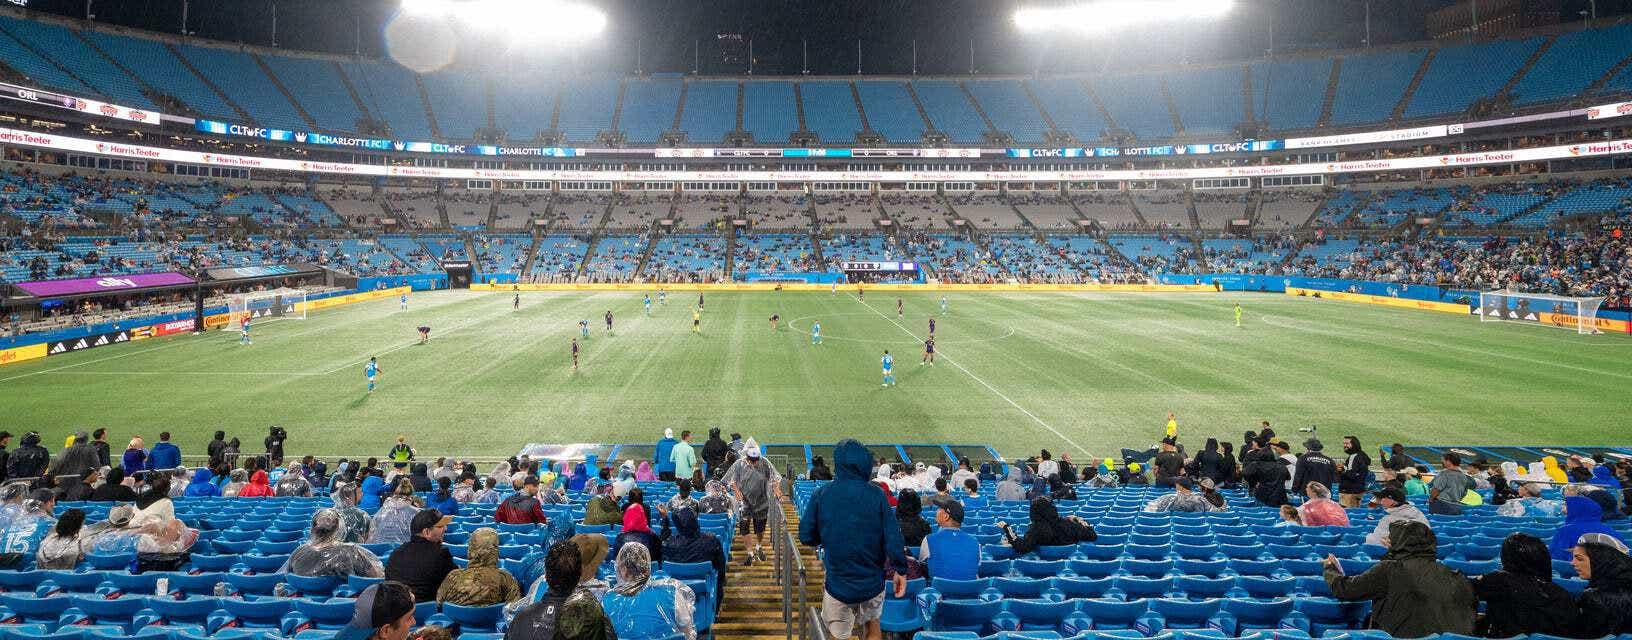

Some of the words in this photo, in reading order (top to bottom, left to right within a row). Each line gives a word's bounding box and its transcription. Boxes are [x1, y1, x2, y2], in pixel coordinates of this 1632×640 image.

[18, 89, 38, 101] ORL
[0, 131, 23, 142] arris
[24, 134, 51, 145] Teeter
[320, 135, 369, 148] CHARLOTTE
[371, 139, 382, 148] FC
[110, 145, 135, 155] Harris
[136, 147, 160, 158] Teeter
[498, 147, 541, 156] CHARLOTTE
[1588, 144, 1622, 153] Harris
[1455, 155, 1483, 163] Harris
[1484, 153, 1514, 162] Teeter
